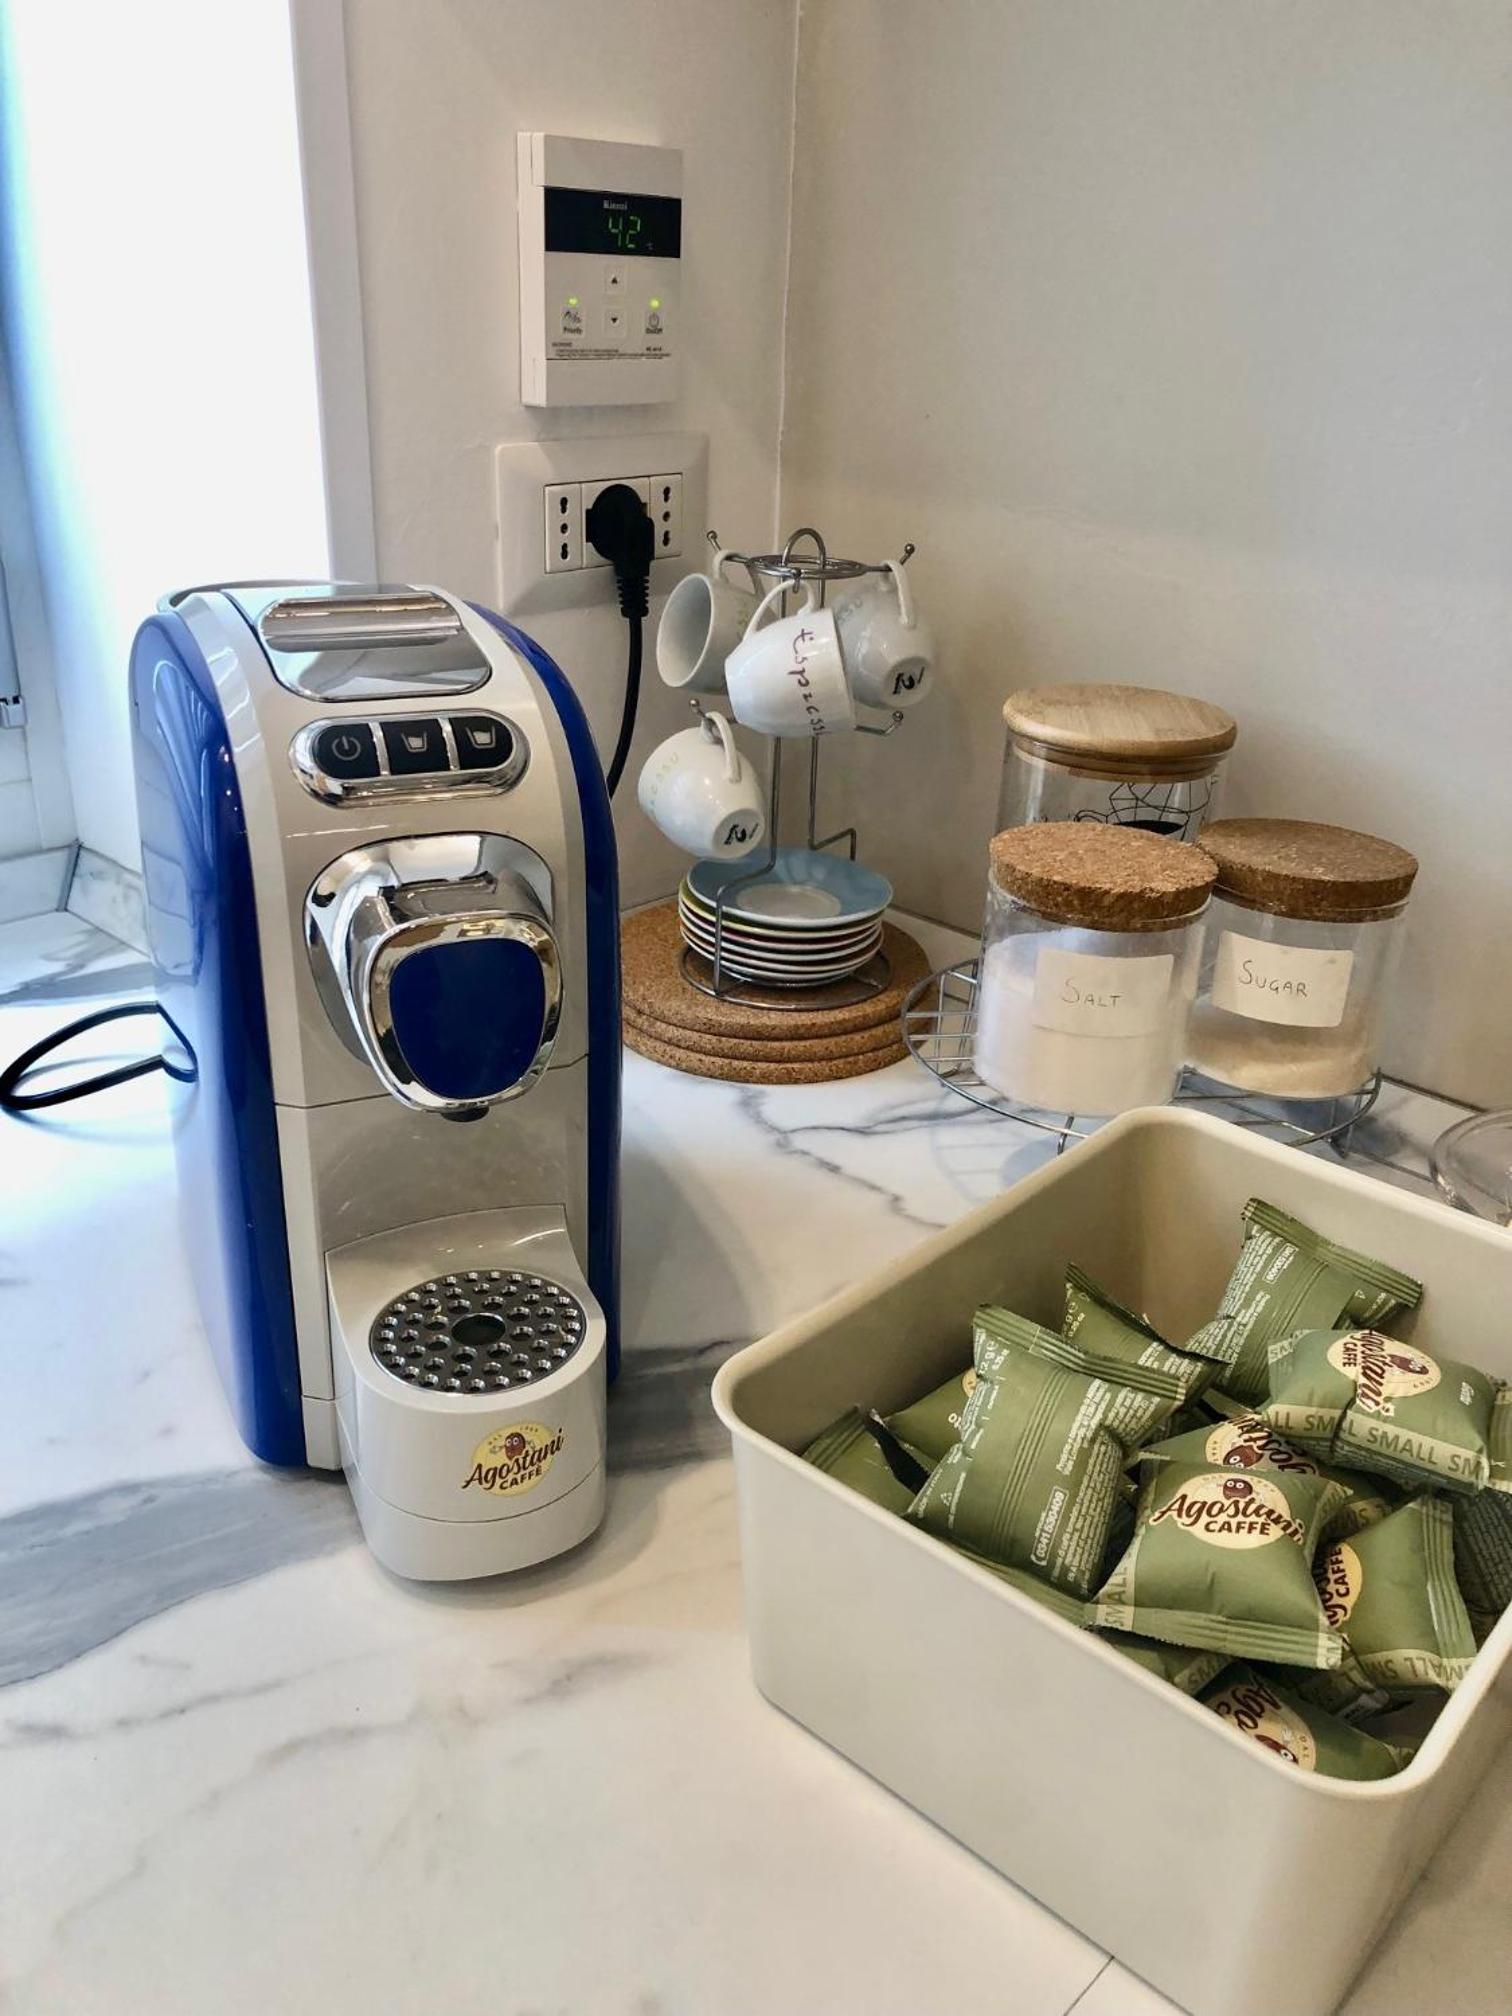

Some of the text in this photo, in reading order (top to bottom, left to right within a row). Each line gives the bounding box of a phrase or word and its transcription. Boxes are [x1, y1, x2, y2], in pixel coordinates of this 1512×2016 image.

[608, 215, 641, 248] 42
[1061, 976, 1122, 1007] SALT
[1239, 959, 1307, 997] SUGAR
[461, 1427, 564, 1491] Agostani
[1262, 1408, 1294, 1431] ALL
[1366, 1426, 1438, 1466] SMALL
[1150, 1493, 1304, 1544] Agostani
